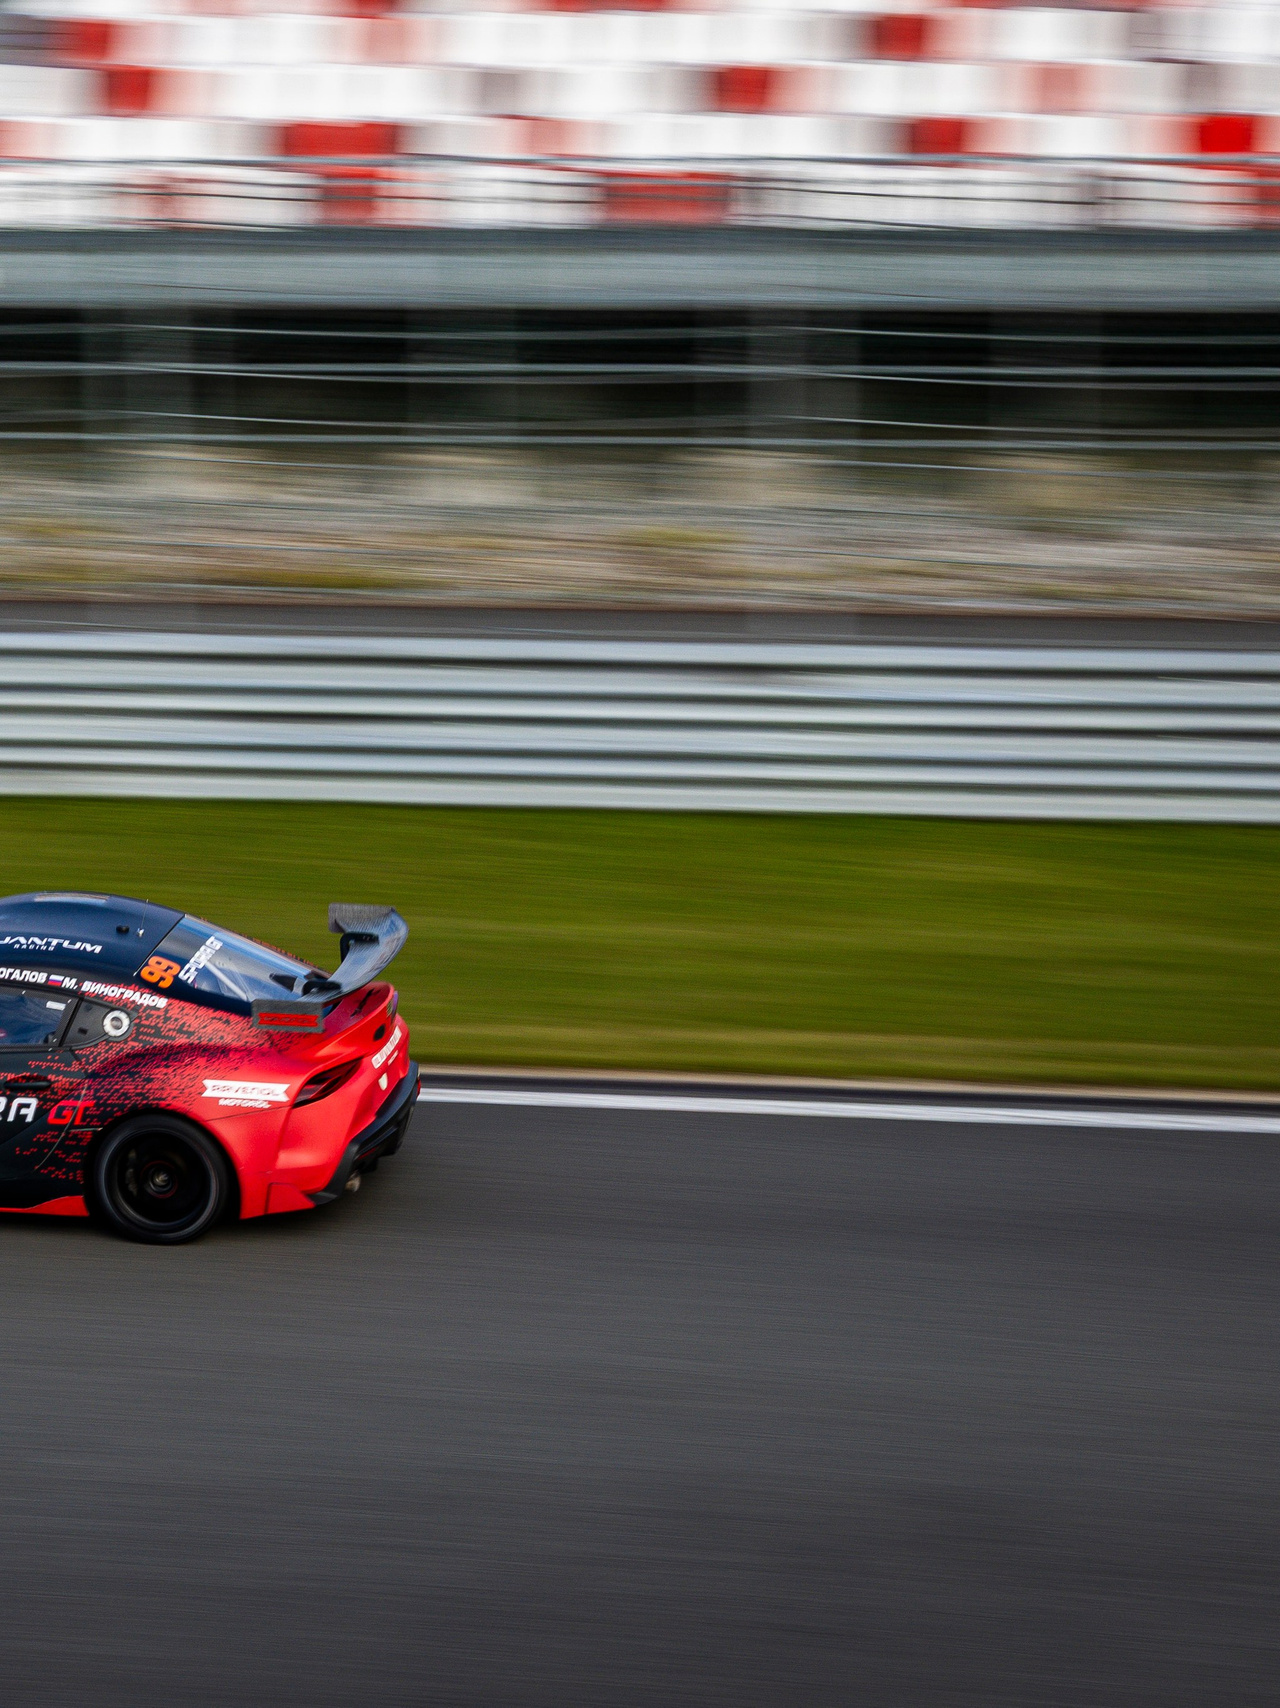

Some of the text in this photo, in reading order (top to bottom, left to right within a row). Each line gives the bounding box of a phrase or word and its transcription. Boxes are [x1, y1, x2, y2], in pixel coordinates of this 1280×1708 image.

[140, 955, 182, 989] 99
[81, 980, 169, 1009] ВИНОГРАДОВ
[47, 1100, 95, 1125] GT
